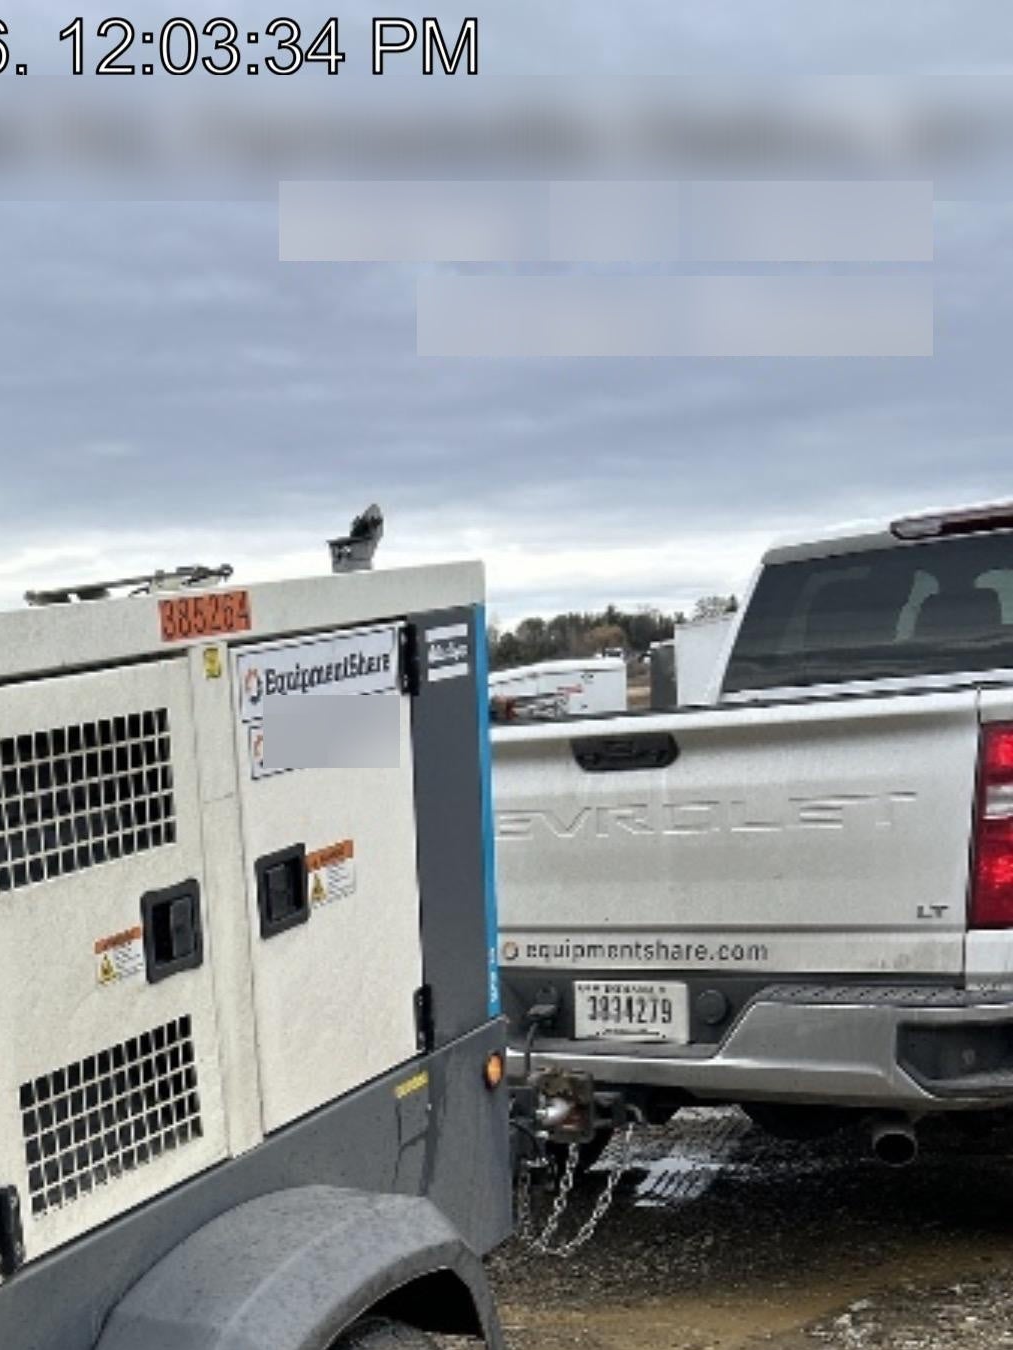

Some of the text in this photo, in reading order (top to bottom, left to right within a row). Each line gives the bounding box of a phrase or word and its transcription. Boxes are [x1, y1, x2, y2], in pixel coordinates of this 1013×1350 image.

[164, 591, 251, 638] 385264
[265, 652, 391, 696] EquipmentShare
[495, 791, 917, 840] EVROLET
[916, 905, 949, 919] LT
[525, 939, 768, 962] equipmentshare.com
